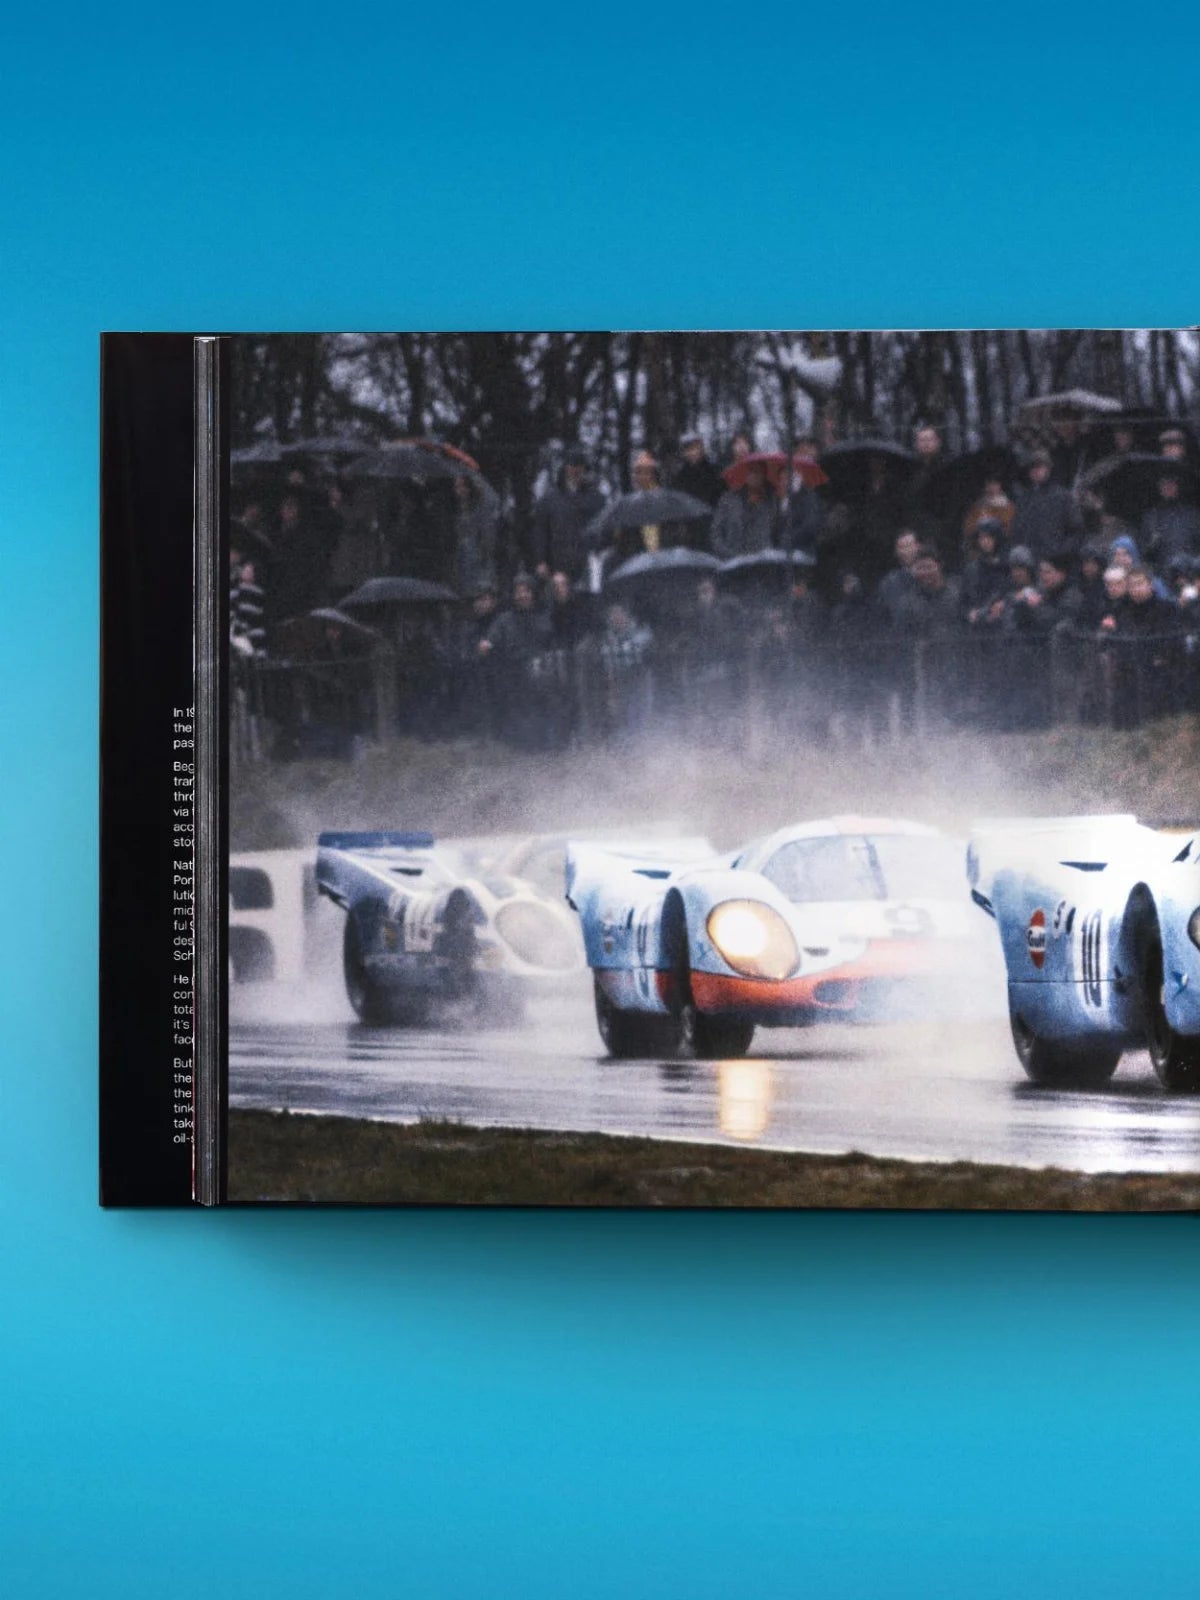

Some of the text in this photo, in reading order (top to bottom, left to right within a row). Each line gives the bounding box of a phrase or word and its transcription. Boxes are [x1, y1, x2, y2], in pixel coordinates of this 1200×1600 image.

[173, 708, 184, 718] In
[173, 723, 192, 733] the
[173, 806, 189, 817] via
[173, 837, 195, 847] sto
[173, 860, 193, 871] Nat
[173, 874, 193, 885] Por
[173, 919, 188, 931] ful
[173, 936, 195, 946] des
[173, 974, 189, 985] He
[173, 1033, 195, 1045] fac
[173, 1057, 193, 1068] But
[173, 1073, 192, 1084] the
[173, 1088, 192, 1099] the
